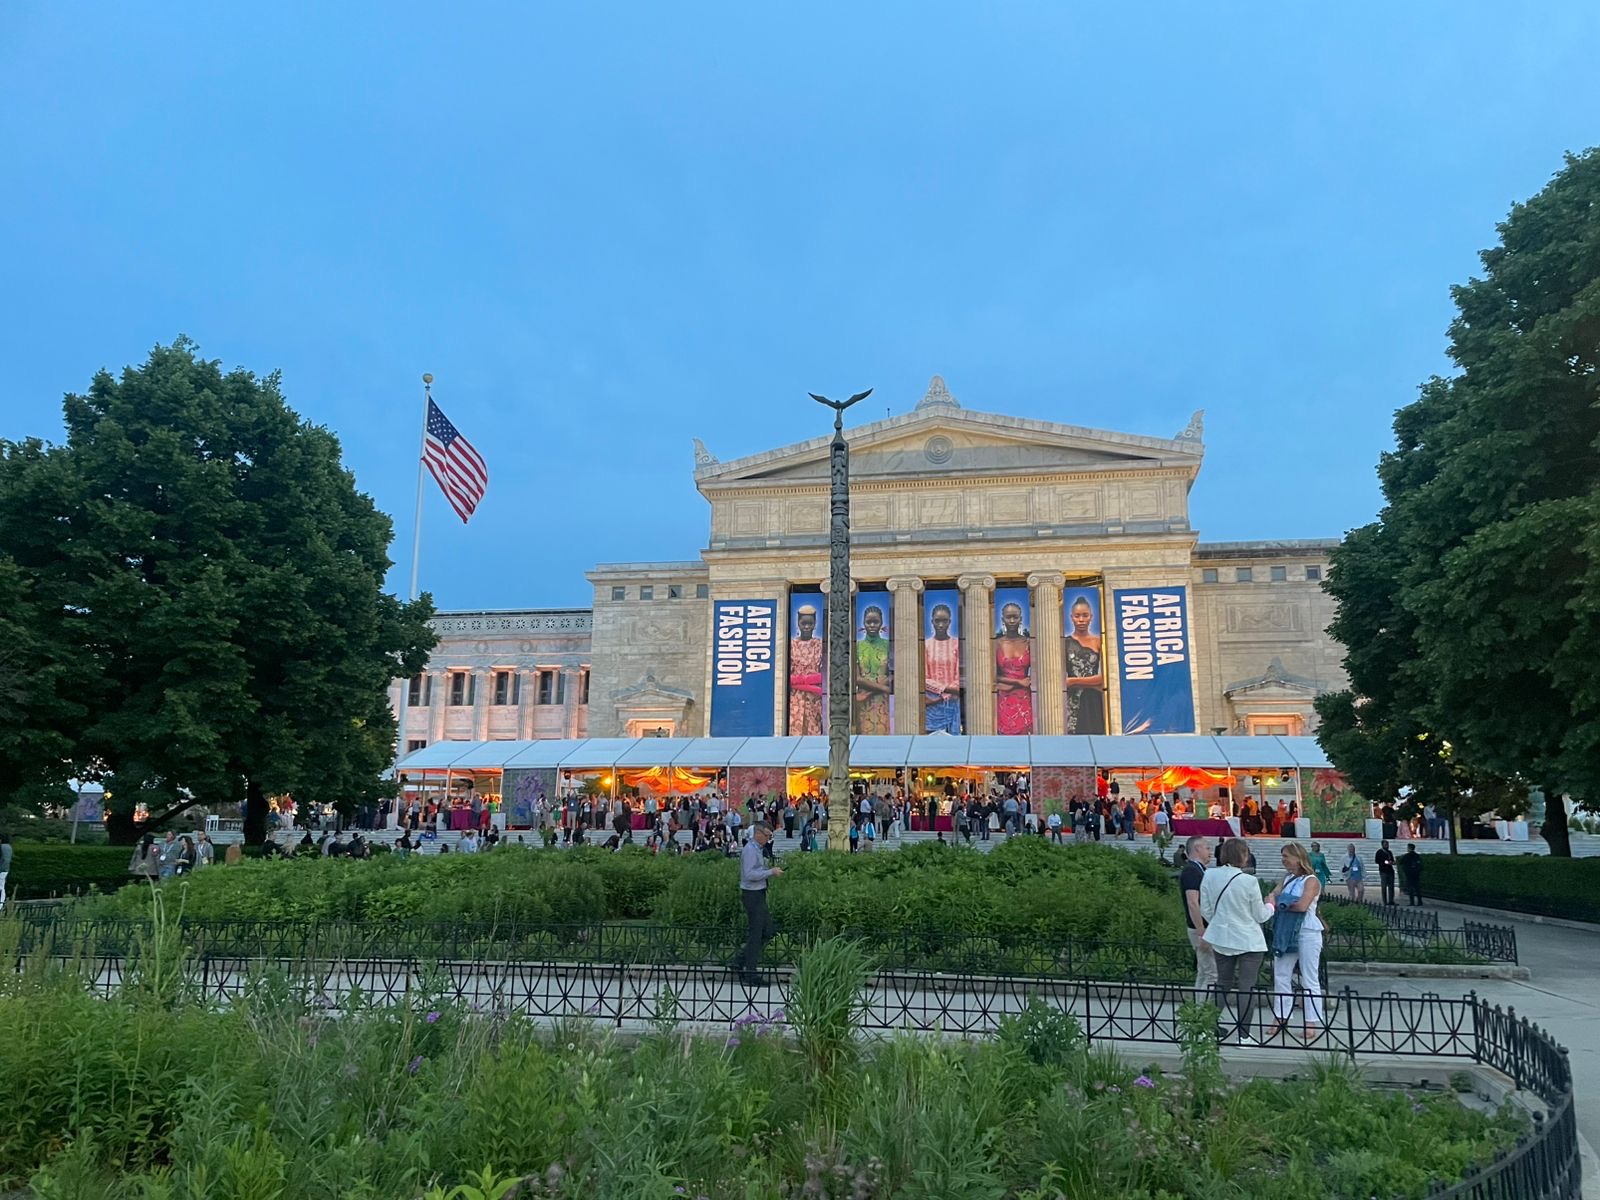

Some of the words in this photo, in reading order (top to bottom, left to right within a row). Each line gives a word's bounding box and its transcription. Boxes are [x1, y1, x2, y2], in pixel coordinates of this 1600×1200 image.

[717, 606, 744, 686] FASHION
[745, 605, 772, 673] AFRICA
[1120, 595, 1154, 681] FASHION
[1152, 593, 1185, 666] AFRICA
